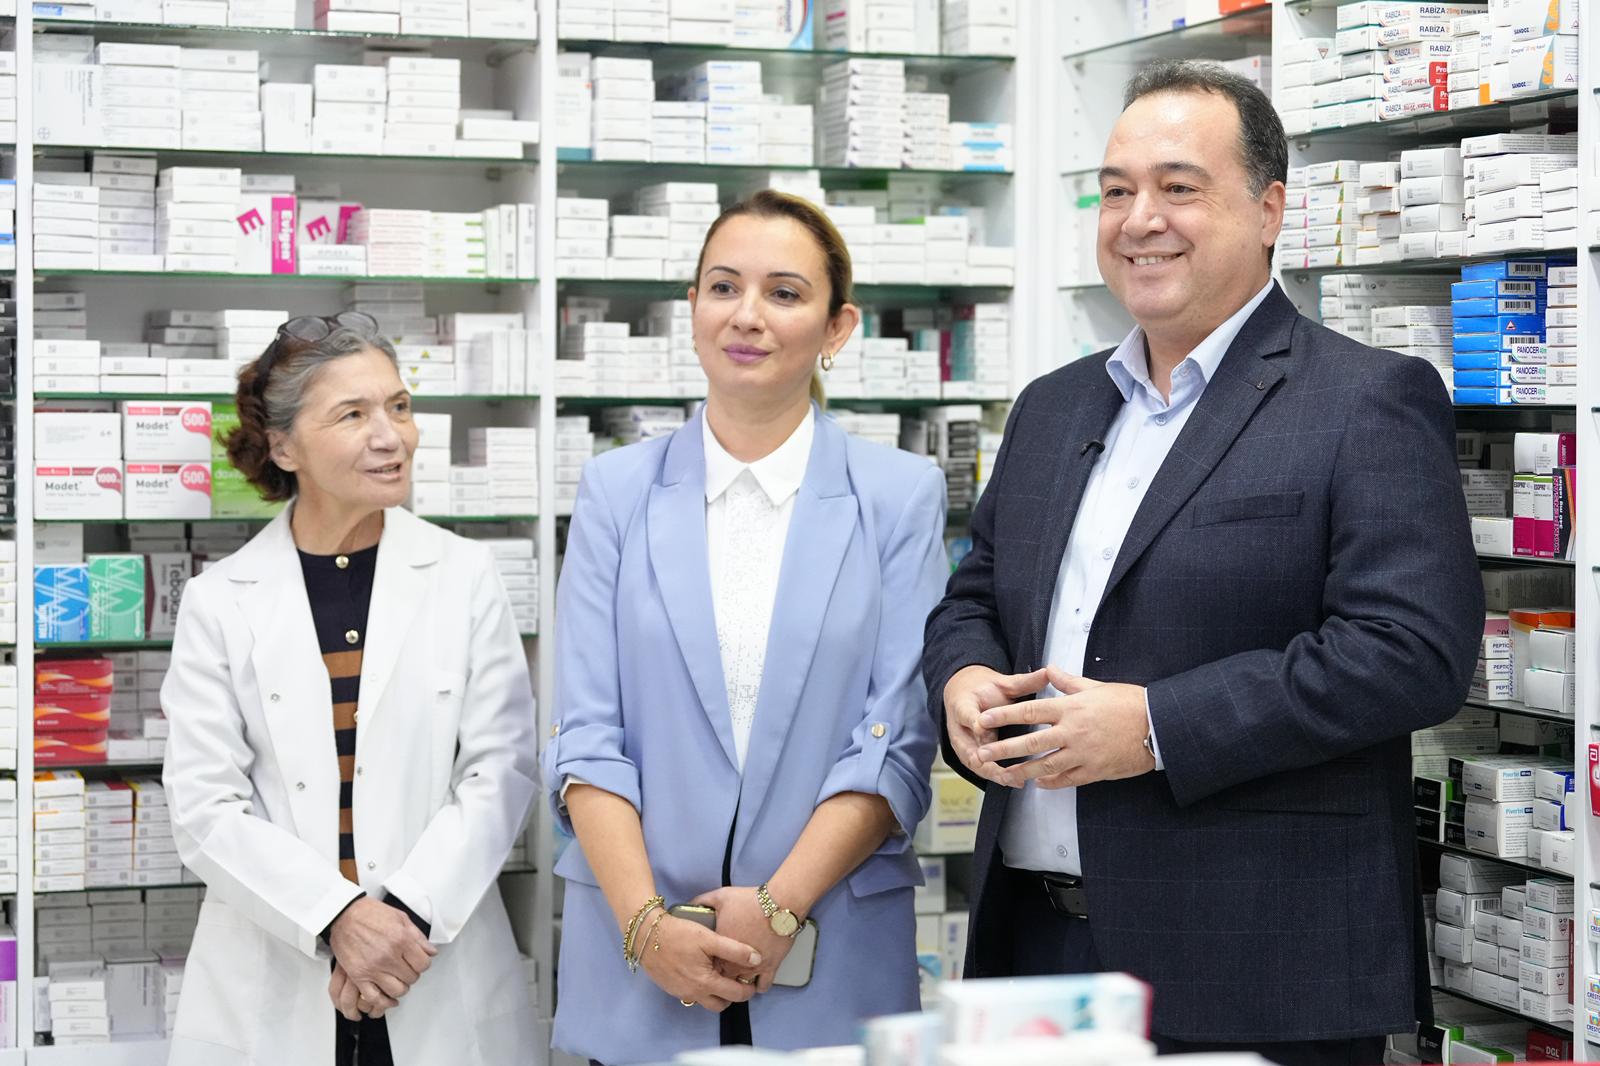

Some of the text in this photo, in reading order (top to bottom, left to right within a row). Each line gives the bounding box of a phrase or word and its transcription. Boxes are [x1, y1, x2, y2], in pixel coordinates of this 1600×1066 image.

[1419, 5, 1446, 14] RABİZA
[1419, 24, 1445, 33] RABİZA
[1513, 27, 1530, 35] SANDOZ
[1511, 81, 1527, 89] SANDOZ
[1516, 346, 1539, 354] PANOCER
[1515, 367, 1538, 375] PANOCER
[1515, 387, 1538, 395] PANOCER
[183, 412, 206, 427] 500
[135, 420, 169, 431] Modet
[183, 470, 206, 484] 500
[44, 481, 79, 491] Modet
[135, 479, 169, 489] Modet
[1545, 1046, 1560, 1058] DGL
